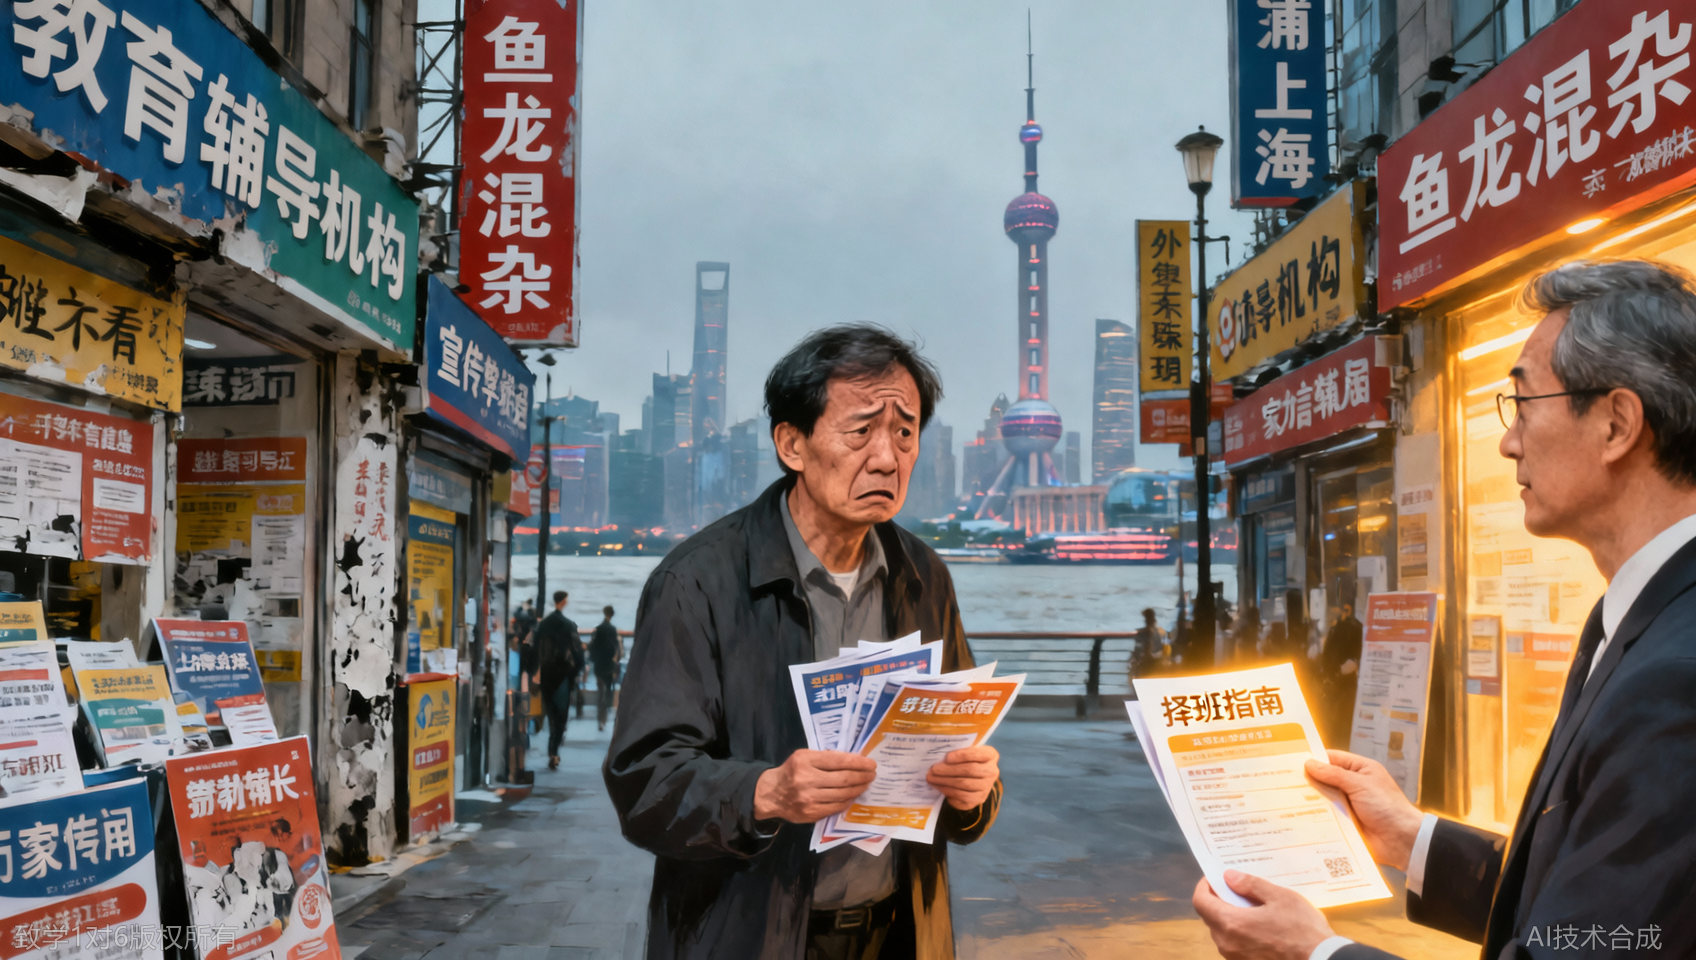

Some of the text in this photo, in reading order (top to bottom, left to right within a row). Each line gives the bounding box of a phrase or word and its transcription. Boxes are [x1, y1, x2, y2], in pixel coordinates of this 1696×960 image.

[13, 0, 406, 300] 教育辅导机构
[478, 16, 553, 314] 鱼龙混杂
[1399, 9, 1693, 255] 鱼龙混杂
[1160, 685, 1285, 728] 择班指南
